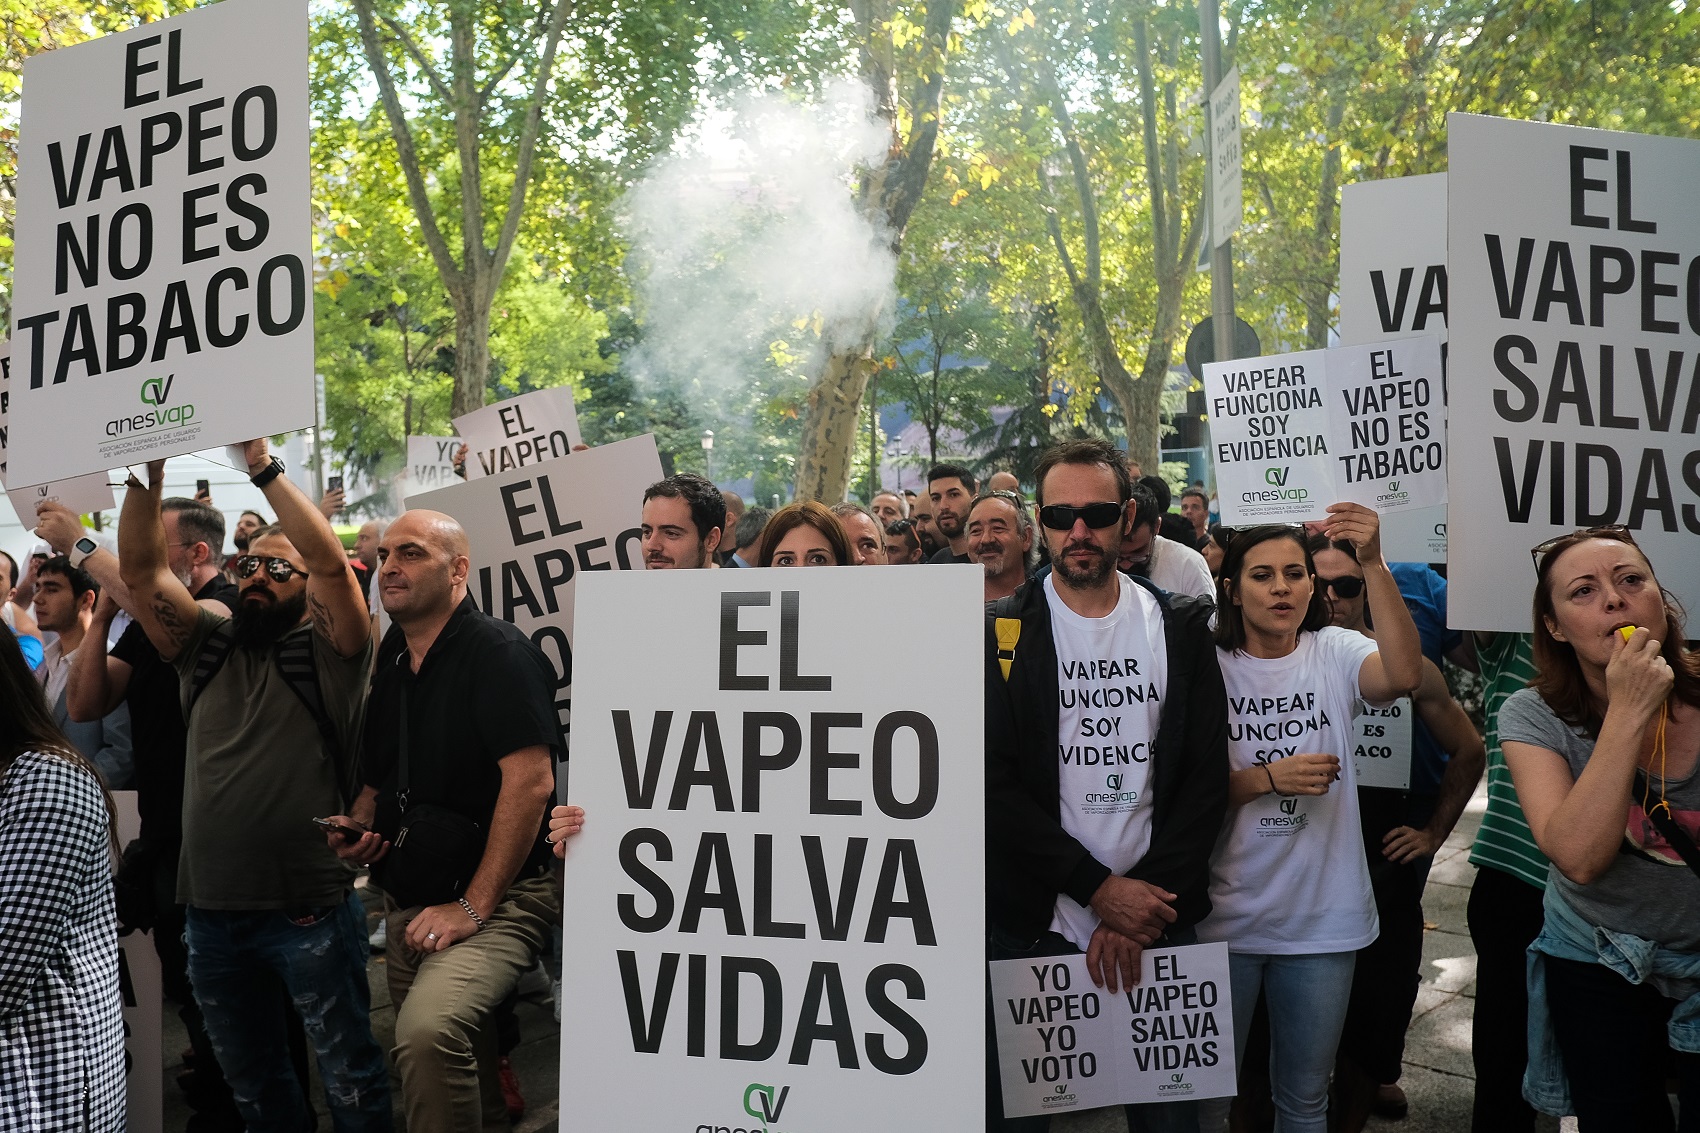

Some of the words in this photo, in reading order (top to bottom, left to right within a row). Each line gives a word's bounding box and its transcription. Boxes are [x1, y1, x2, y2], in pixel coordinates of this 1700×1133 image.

[124, 28, 203, 109] EL
[47, 85, 277, 209] VAPEO
[1569, 145, 1657, 234] EL
[55, 203, 153, 295] NO
[182, 173, 269, 264] ES
[17, 254, 305, 390] TABACO
[1223, 365, 1306, 393] VAPEAR
[1370, 350, 1403, 380] EL
[1214, 387, 1323, 418] FUNCIONA
[1342, 378, 1430, 417] VAPEO
[106, 404, 195, 438] anesvap
[498, 404, 535, 439] EL
[1248, 414, 1290, 438] SOY
[1350, 417, 1389, 449] NO
[1398, 411, 1430, 442] ES
[1218, 435, 1328, 463] EVIDENCIA
[1339, 442, 1442, 483] TABACO
[500, 474, 583, 547] EL
[1242, 488, 1308, 504] anesvap
[718, 590, 832, 692] EL
[1062, 658, 1141, 680] VAPEAR
[1060, 682, 1160, 709] UNCIONA
[1080, 716, 1121, 737] SOY
[1228, 710, 1331, 741] UNCIONA
[1363, 724, 1385, 737] ES
[611, 710, 939, 820] VAPEO
[1355, 744, 1392, 758] ACO
[1086, 791, 1137, 804] anesvap
[616, 827, 937, 946] SALVA
[1031, 963, 1070, 992] YO
[1154, 955, 1187, 982] EL
[616, 950, 928, 1076] VIDAS
[1008, 992, 1100, 1025] VAPEO
[1126, 981, 1217, 1014] VAPEO
[1037, 1025, 1076, 1053] YO
[1131, 1012, 1219, 1043] SALVA
[1021, 1052, 1097, 1084] VOTO
[1133, 1041, 1219, 1072] VIDAS
